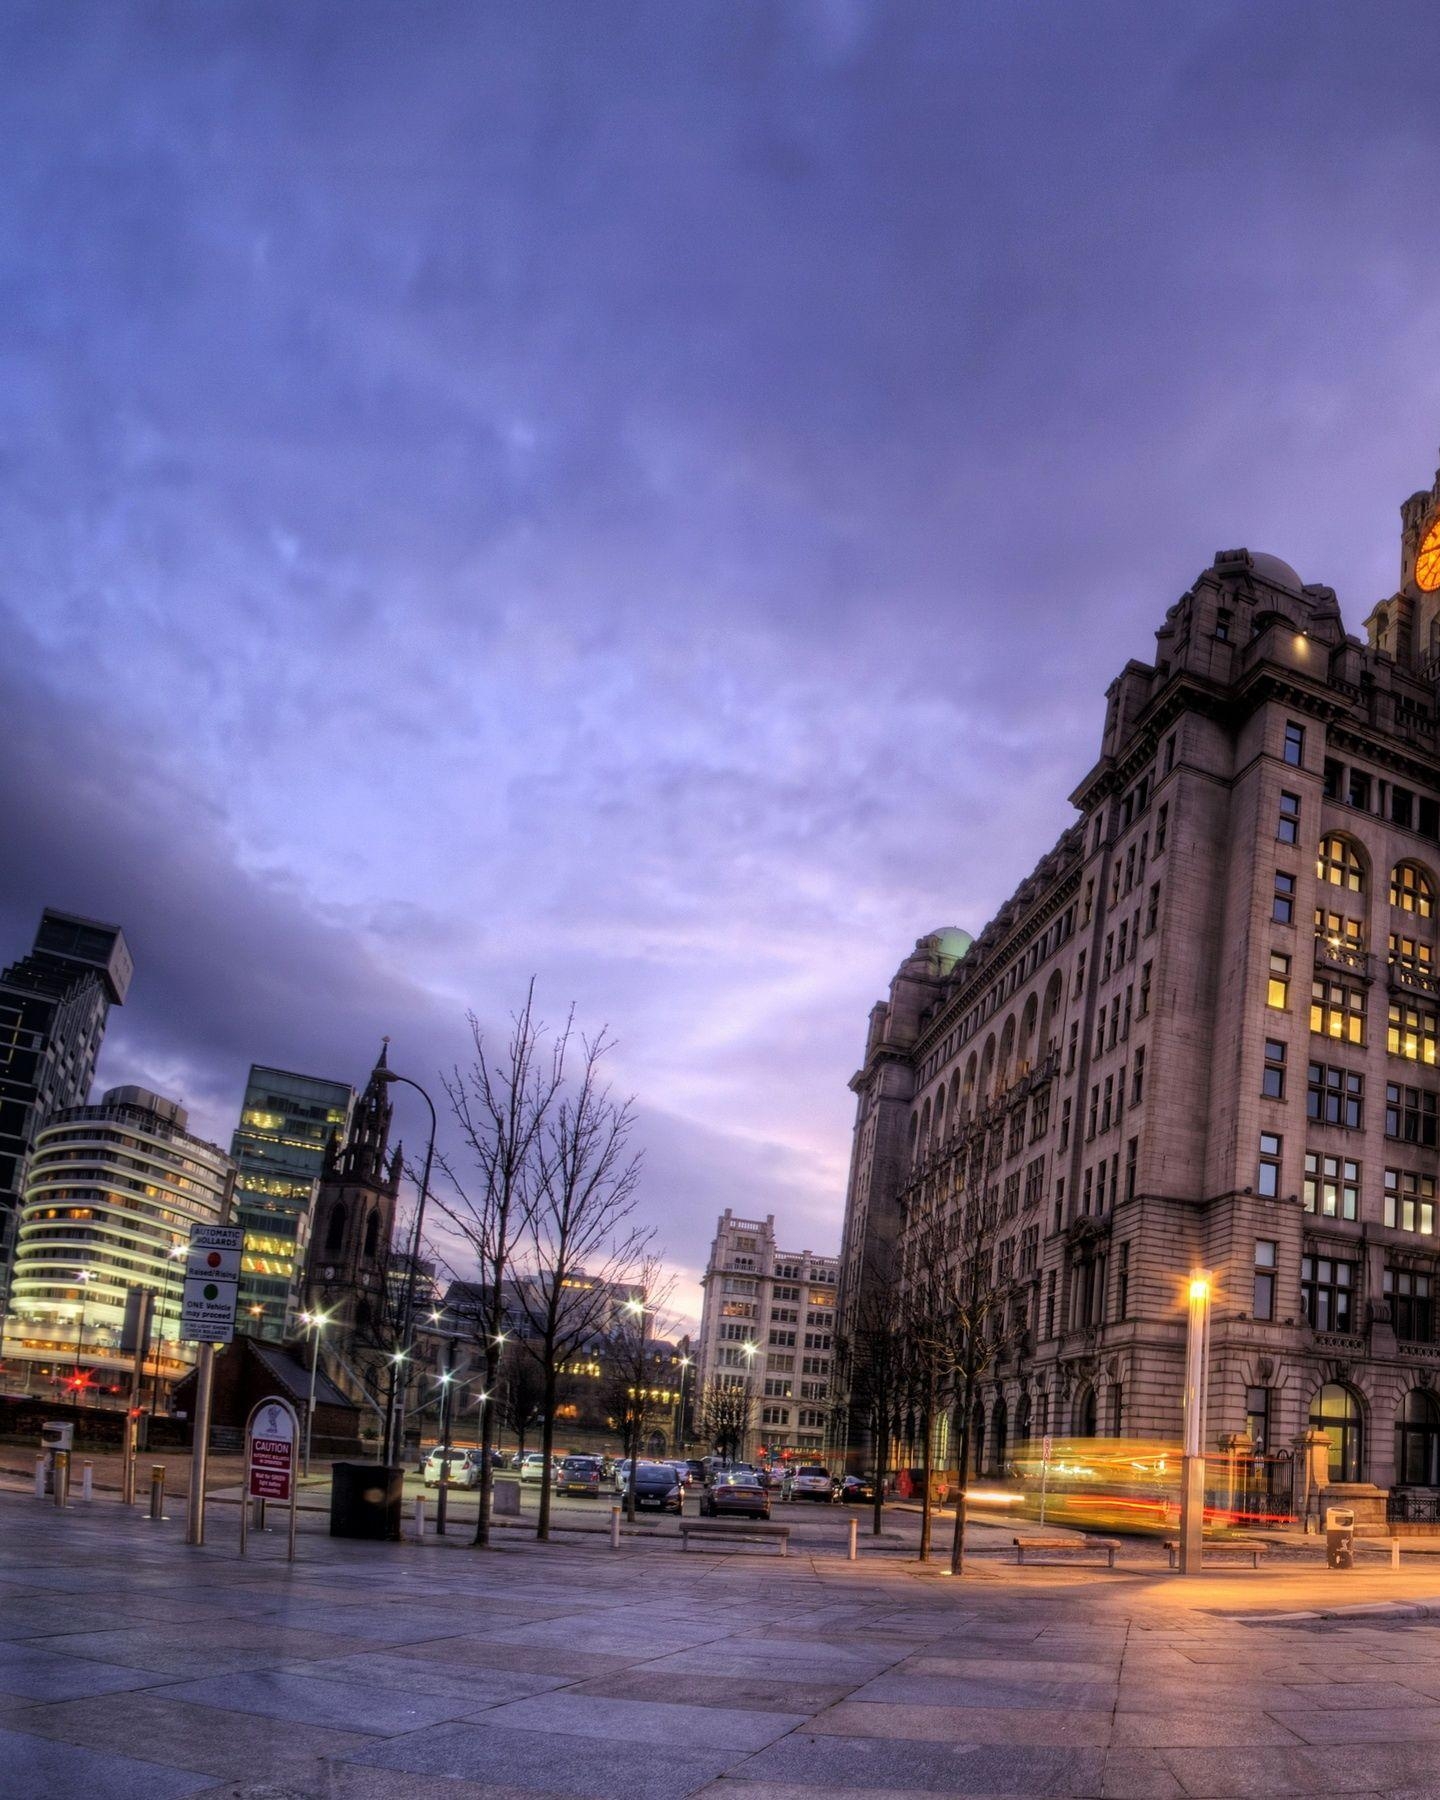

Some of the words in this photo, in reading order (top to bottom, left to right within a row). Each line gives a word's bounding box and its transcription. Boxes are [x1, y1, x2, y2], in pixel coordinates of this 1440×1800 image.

[194, 1228, 241, 1239] AUTOMATIC
[195, 1236, 237, 1247] BOLLARDS
[186, 1300, 204, 1309] ONE
[206, 1302, 231, 1311] Vehicle
[185, 1310, 200, 1318] may
[202, 1312, 231, 1320] proceed
[255, 1440, 289, 1454] CAUTION
